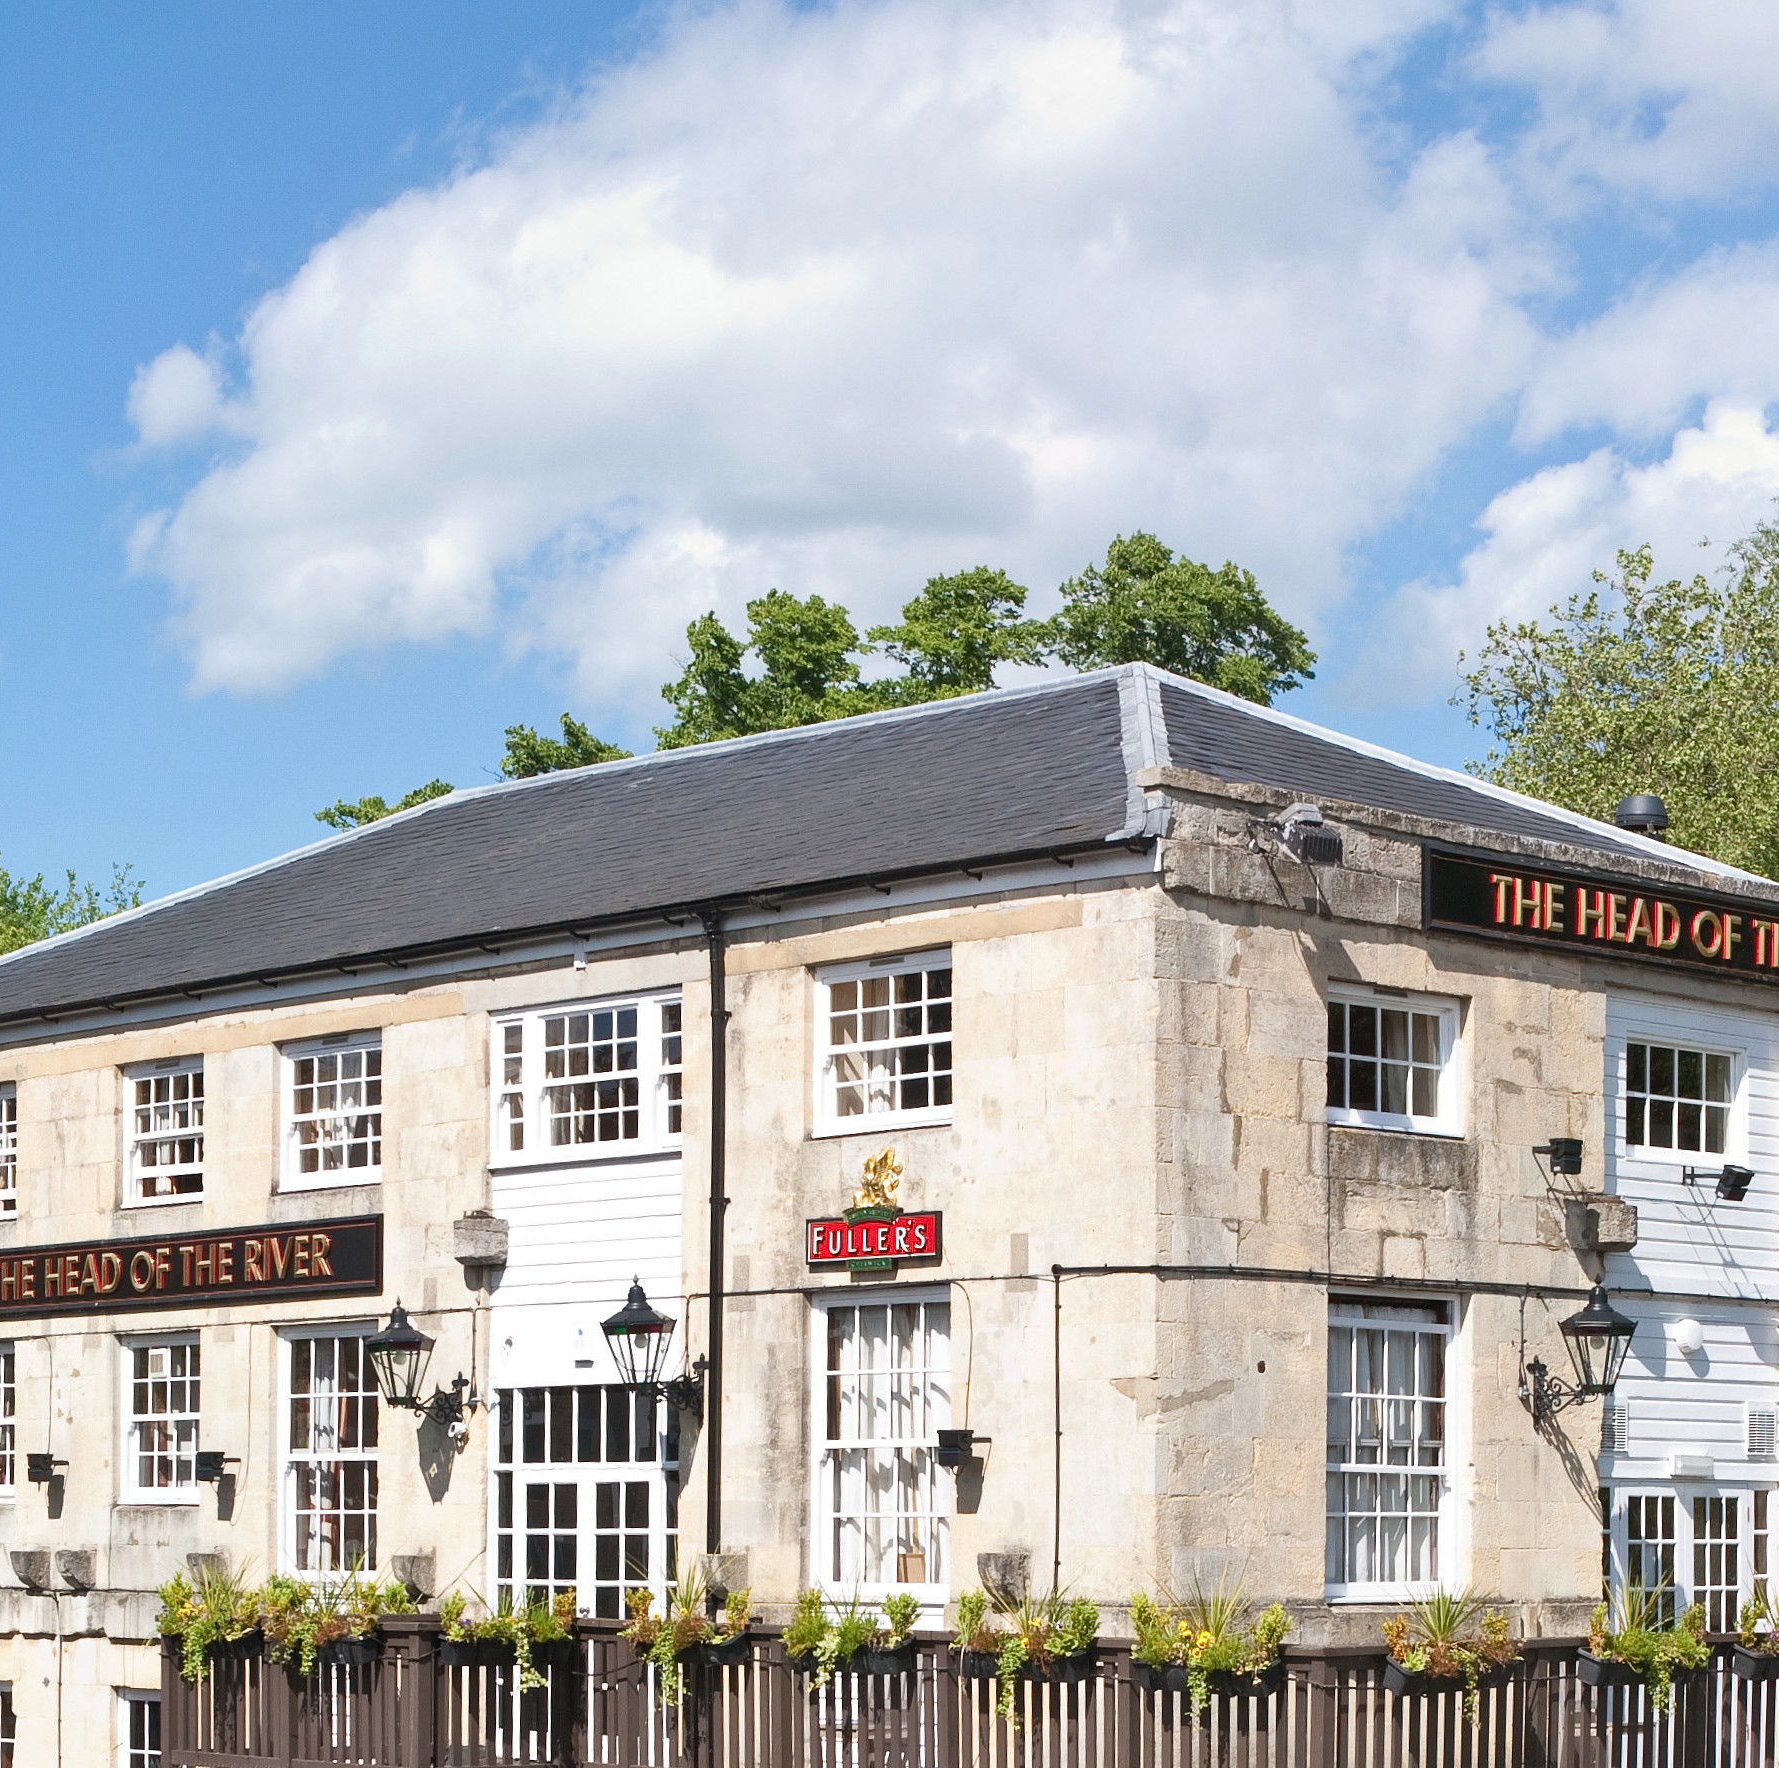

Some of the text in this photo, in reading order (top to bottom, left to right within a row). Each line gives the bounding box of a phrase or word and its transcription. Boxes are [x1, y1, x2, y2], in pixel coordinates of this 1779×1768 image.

[1489, 873, 1565, 932] THE
[1576, 887, 1682, 951] HEAD
[1692, 910, 1743, 960] OF
[44, 1252, 122, 1297] HEAD
[130, 1247, 172, 1293] OF
[179, 1242, 234, 1287] THE
[244, 1233, 333, 1282] RIVER
[813, 1219, 926, 1256] FULLER'S
